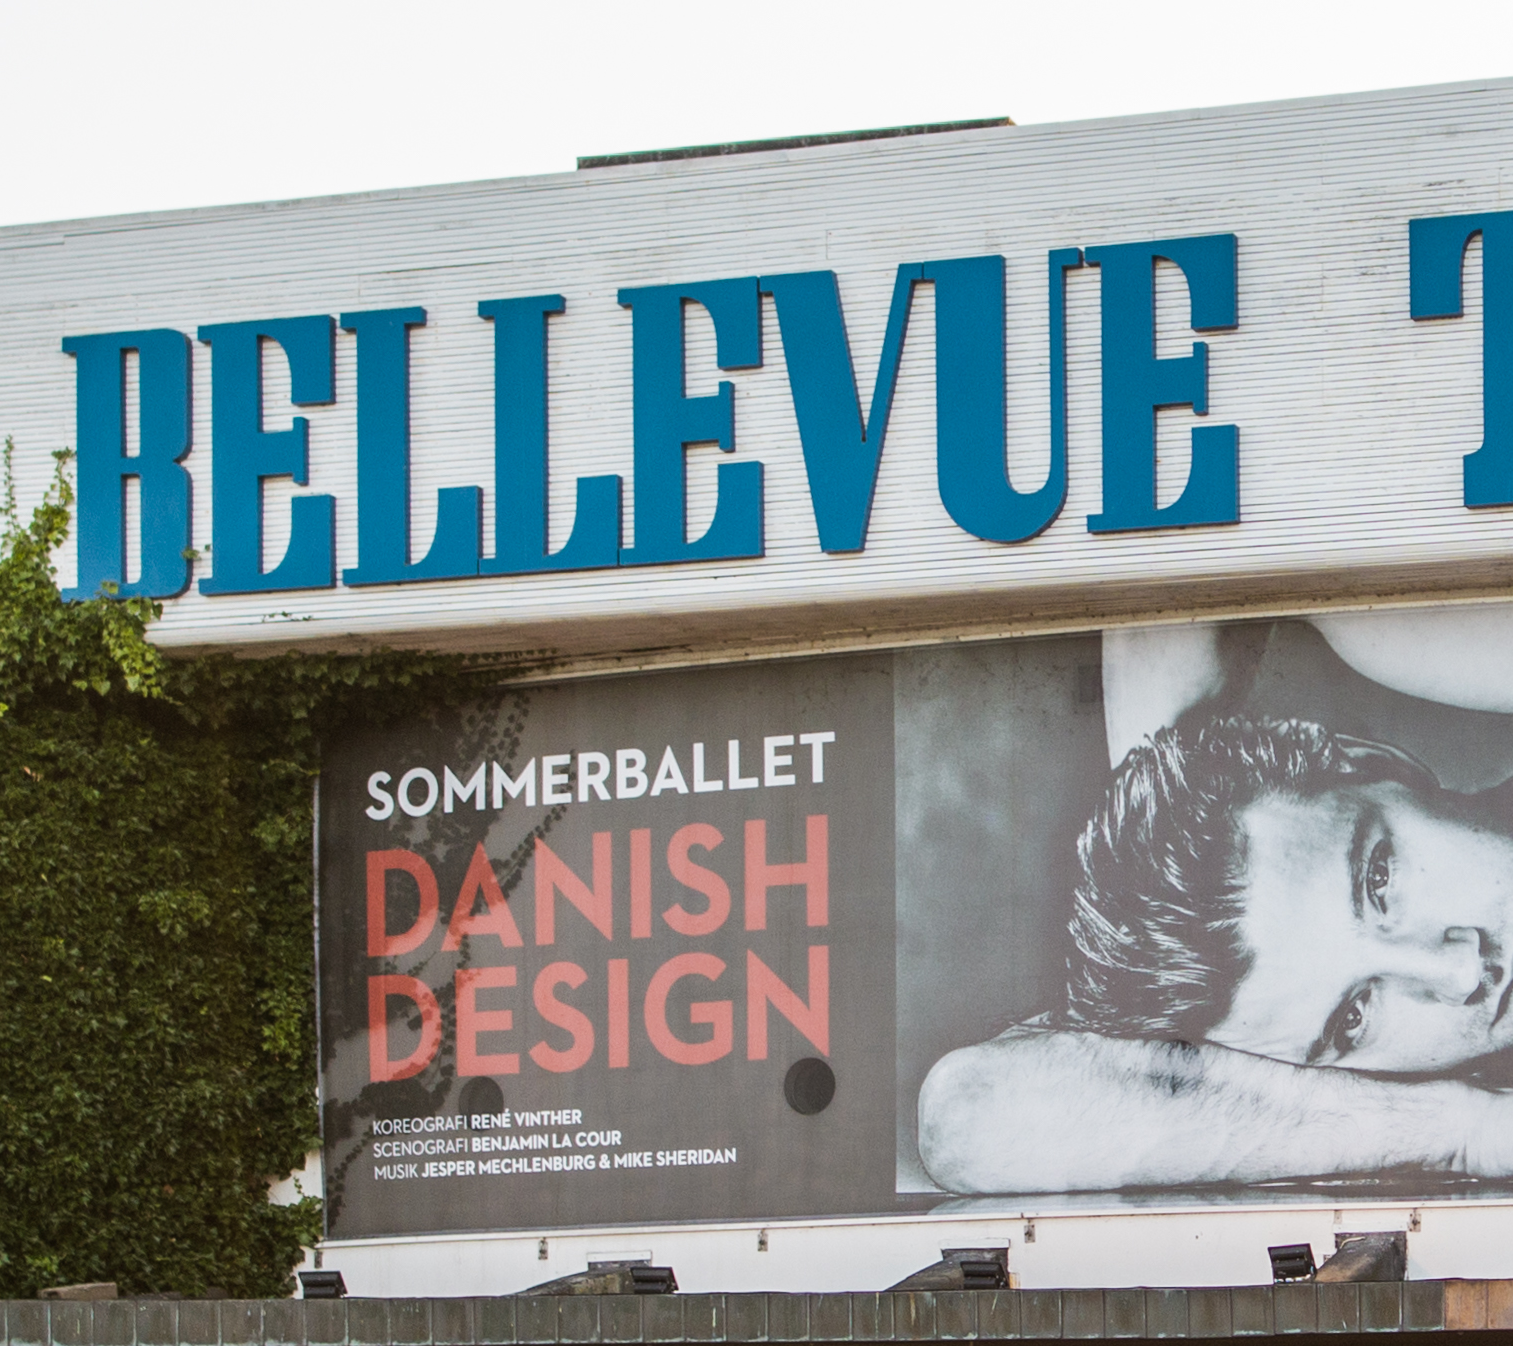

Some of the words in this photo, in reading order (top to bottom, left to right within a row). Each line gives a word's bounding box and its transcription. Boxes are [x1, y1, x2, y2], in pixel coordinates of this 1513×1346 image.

[61, 232, 1240, 602] BELLEVUE
[365, 731, 836, 821] SOMMERBALLET
[366, 814, 829, 957] DANISH
[367, 945, 830, 1083] DESIGN
[372, 1115, 468, 1135] KOREOGRAFI
[471, 1108, 512, 1130] RENÉ
[514, 1109, 583, 1127] VINTHER
[373, 1137, 468, 1158] SCENOGRAFI
[471, 1133, 549, 1153] BENJAMIN
[552, 1133, 573, 1148] LA
[575, 1130, 622, 1148] COUR
[374, 1163, 419, 1181] MUSIK
[421, 1160, 476, 1178] JESPER
[478, 1154, 595, 1175] MECHLENBURG
[598, 1153, 611, 1170] &
[613, 1151, 653, 1169] MIKE
[655, 1147, 737, 1167] SHERIDAN
